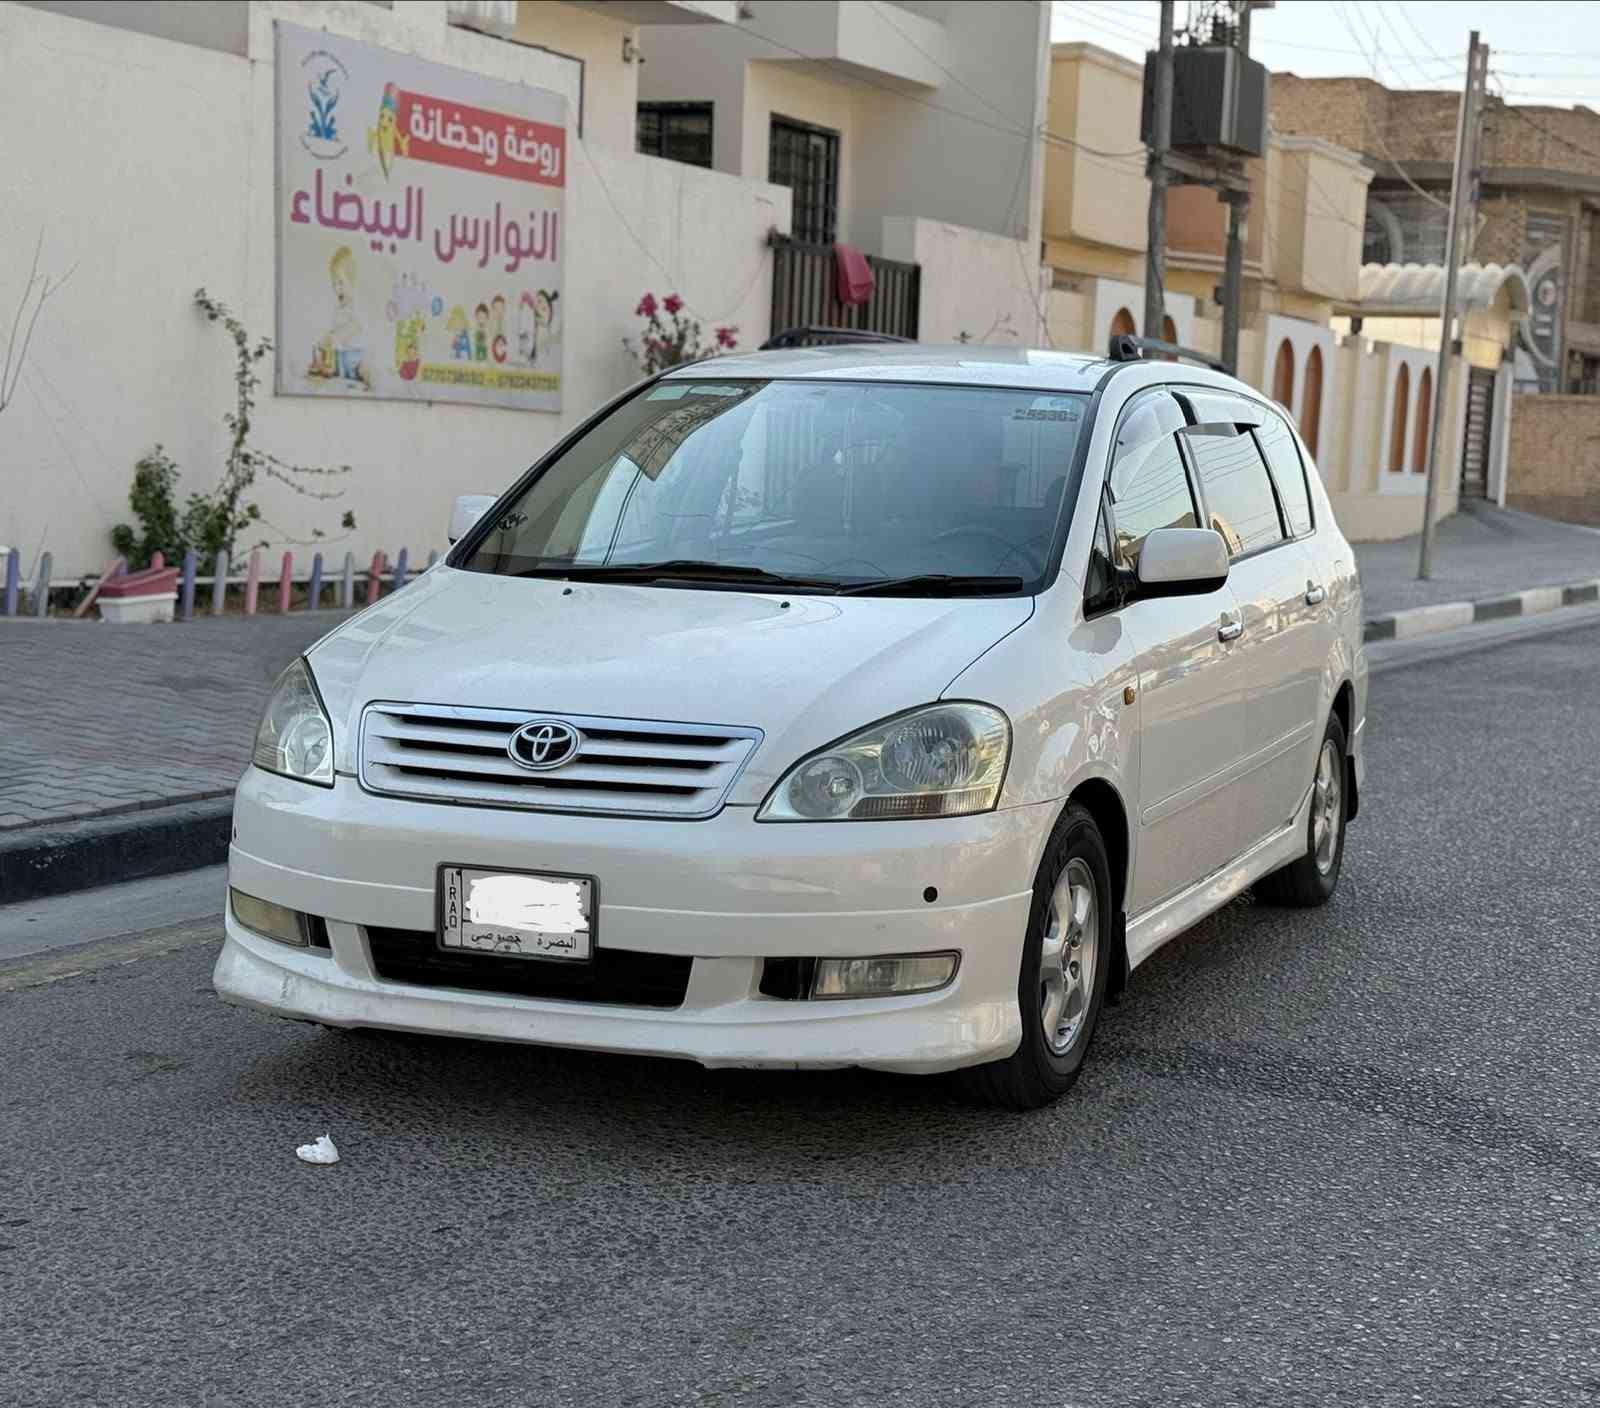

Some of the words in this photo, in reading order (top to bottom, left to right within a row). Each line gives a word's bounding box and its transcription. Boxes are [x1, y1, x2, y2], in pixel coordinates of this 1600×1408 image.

[410, 103, 498, 166] وحضانة
[504, 125, 560, 178] روضة
[290, 168, 423, 254] البيضاء
[434, 201, 558, 273] النوارس
[449, 872, 458, 930] IRAQ
[537, 933, 577, 954] البصرة
